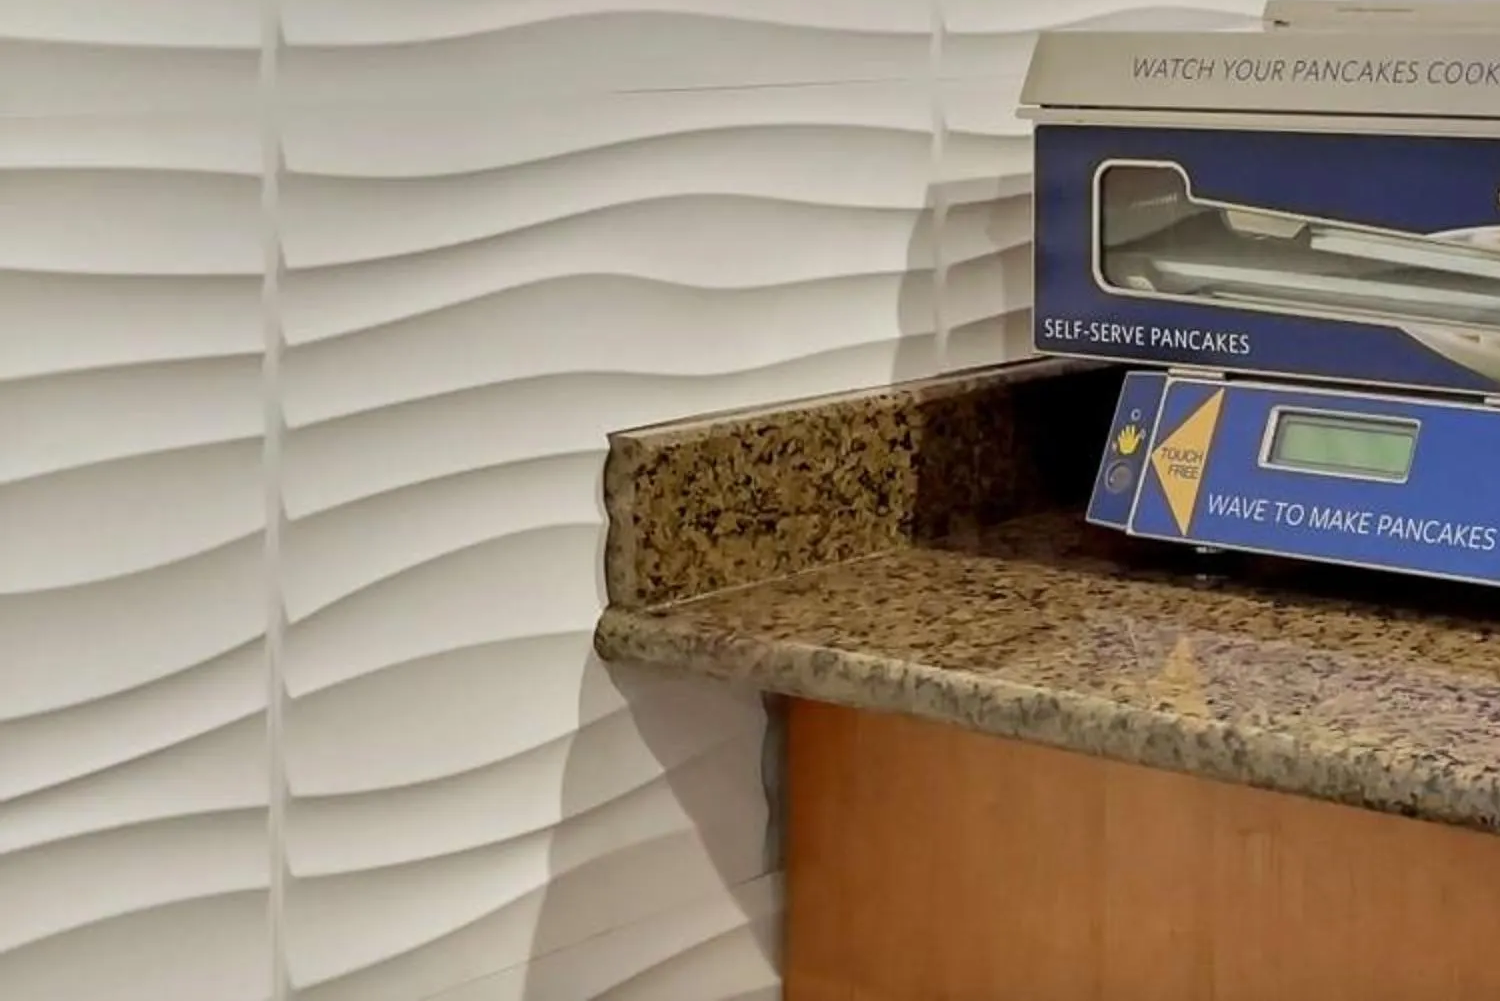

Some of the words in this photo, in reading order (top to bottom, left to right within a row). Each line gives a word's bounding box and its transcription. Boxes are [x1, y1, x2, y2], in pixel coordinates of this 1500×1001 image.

[1133, 57, 1214, 80] WATCH
[1223, 59, 1285, 81] YOUR
[1292, 60, 1418, 84] PANCAKES
[1044, 318, 1145, 346] SELF-SERVE
[1150, 326, 1250, 355] PANCAKES
[1160, 447, 1204, 463] TOUCH
[1167, 464, 1200, 480] FREE
[1208, 494, 1269, 521] WAVE
[1274, 501, 1304, 526] TO
[1308, 507, 1373, 535] MAKE
[1376, 514, 1498, 550] PANCAKES
